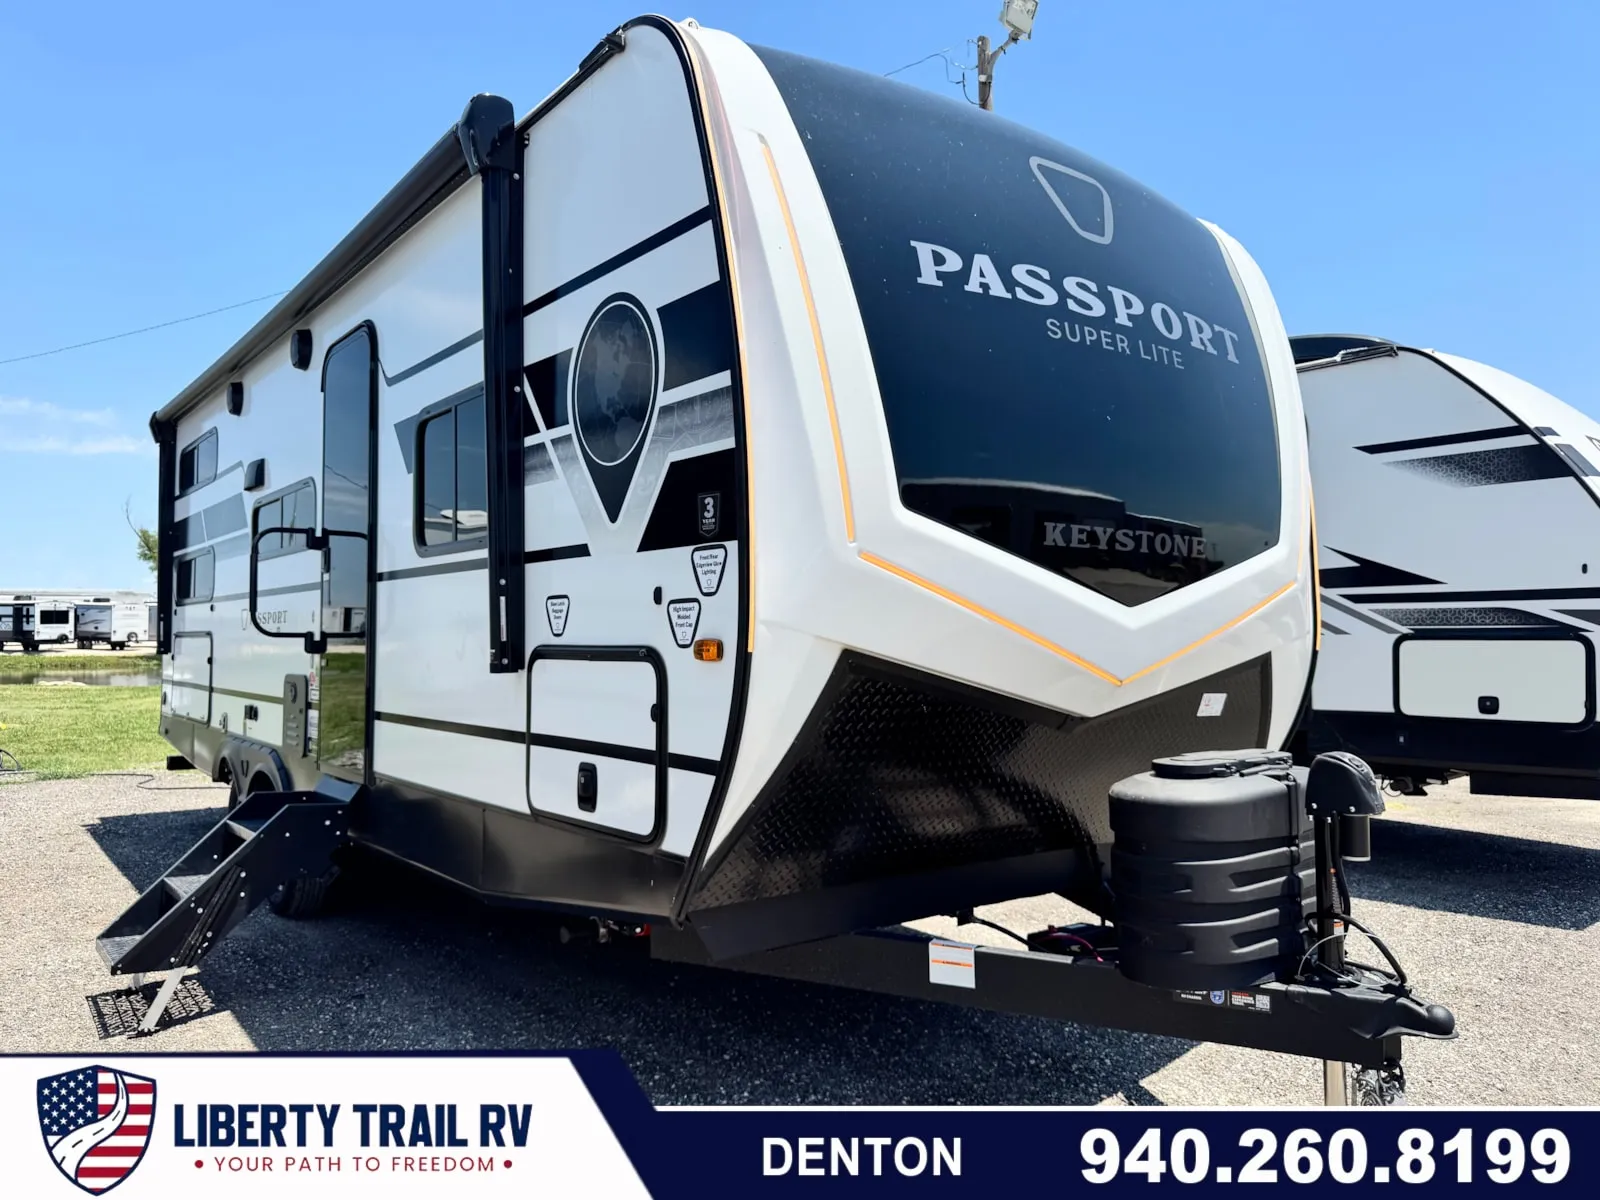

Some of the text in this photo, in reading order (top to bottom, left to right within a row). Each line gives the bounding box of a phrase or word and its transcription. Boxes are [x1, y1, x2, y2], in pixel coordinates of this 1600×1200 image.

[910, 240, 1240, 365] PASSPORT
[1046, 319, 1185, 370] SUPER LITE
[703, 497, 714, 518] 3
[1043, 521, 1207, 558] KEYSTONE
